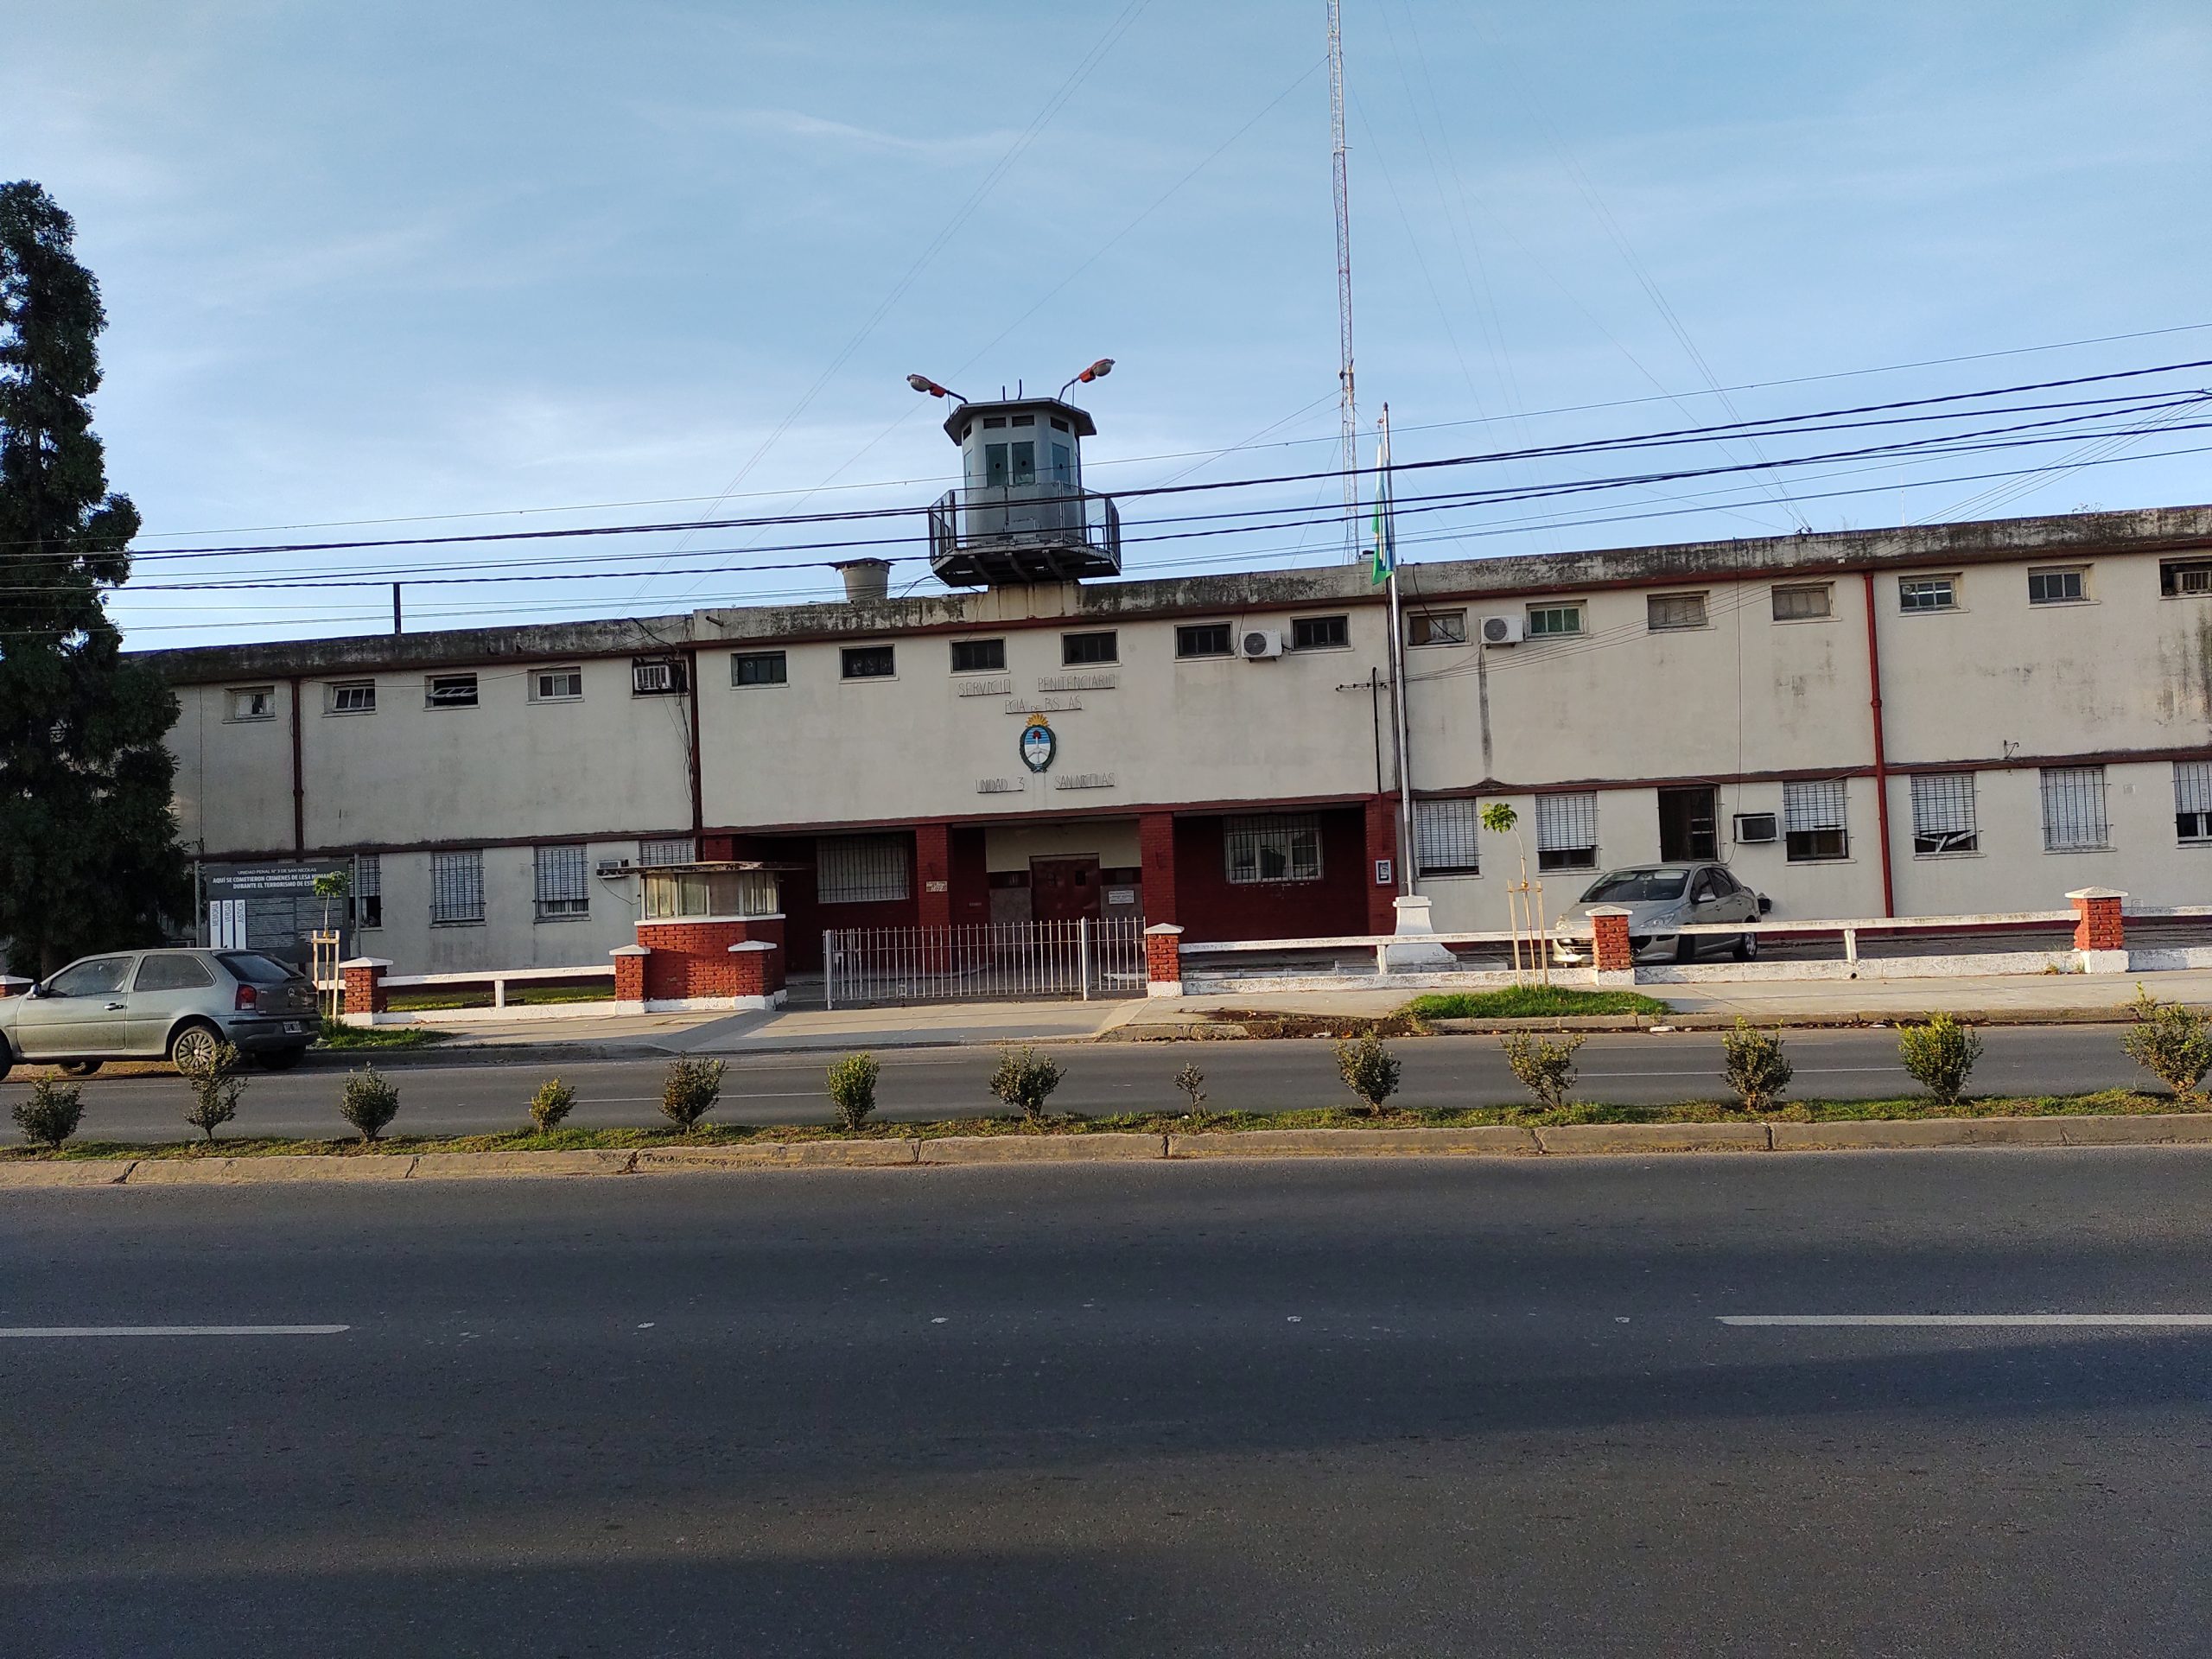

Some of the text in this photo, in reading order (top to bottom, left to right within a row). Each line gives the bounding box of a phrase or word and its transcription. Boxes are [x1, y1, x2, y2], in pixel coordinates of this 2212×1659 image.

[958, 674, 1116, 696] SERVICIO PENITENCIARIO
[976, 778, 1008, 792] UNIDAD
[1017, 777, 1025, 790] 3
[1054, 774, 1072, 788] SAN
